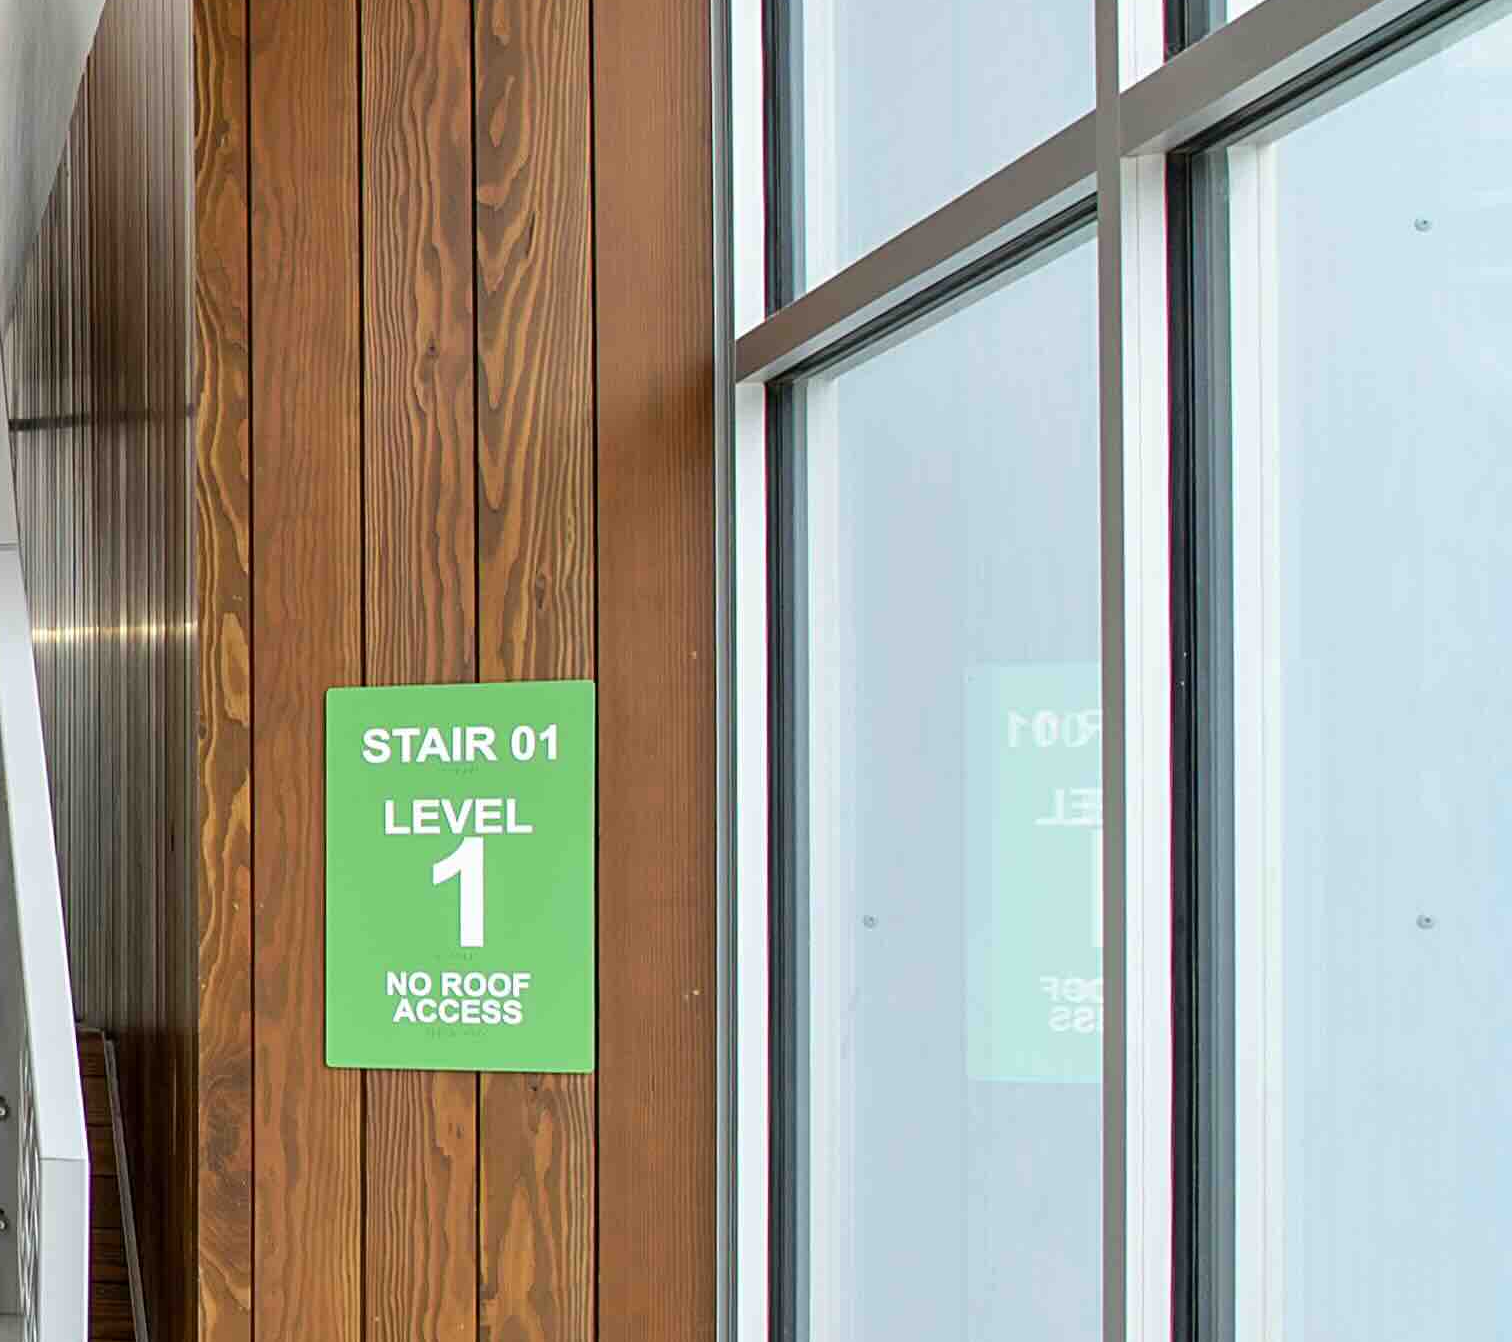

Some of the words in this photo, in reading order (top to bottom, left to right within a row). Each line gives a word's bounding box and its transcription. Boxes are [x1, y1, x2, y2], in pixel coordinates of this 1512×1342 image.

[362, 726, 497, 764] STAIR
[510, 723, 557, 761] 01
[384, 798, 533, 835] LEVEL
[431, 835, 484, 948] 1
[387, 971, 432, 997] NO
[441, 972, 532, 998] ROOF
[392, 998, 523, 1025] ACCESS
